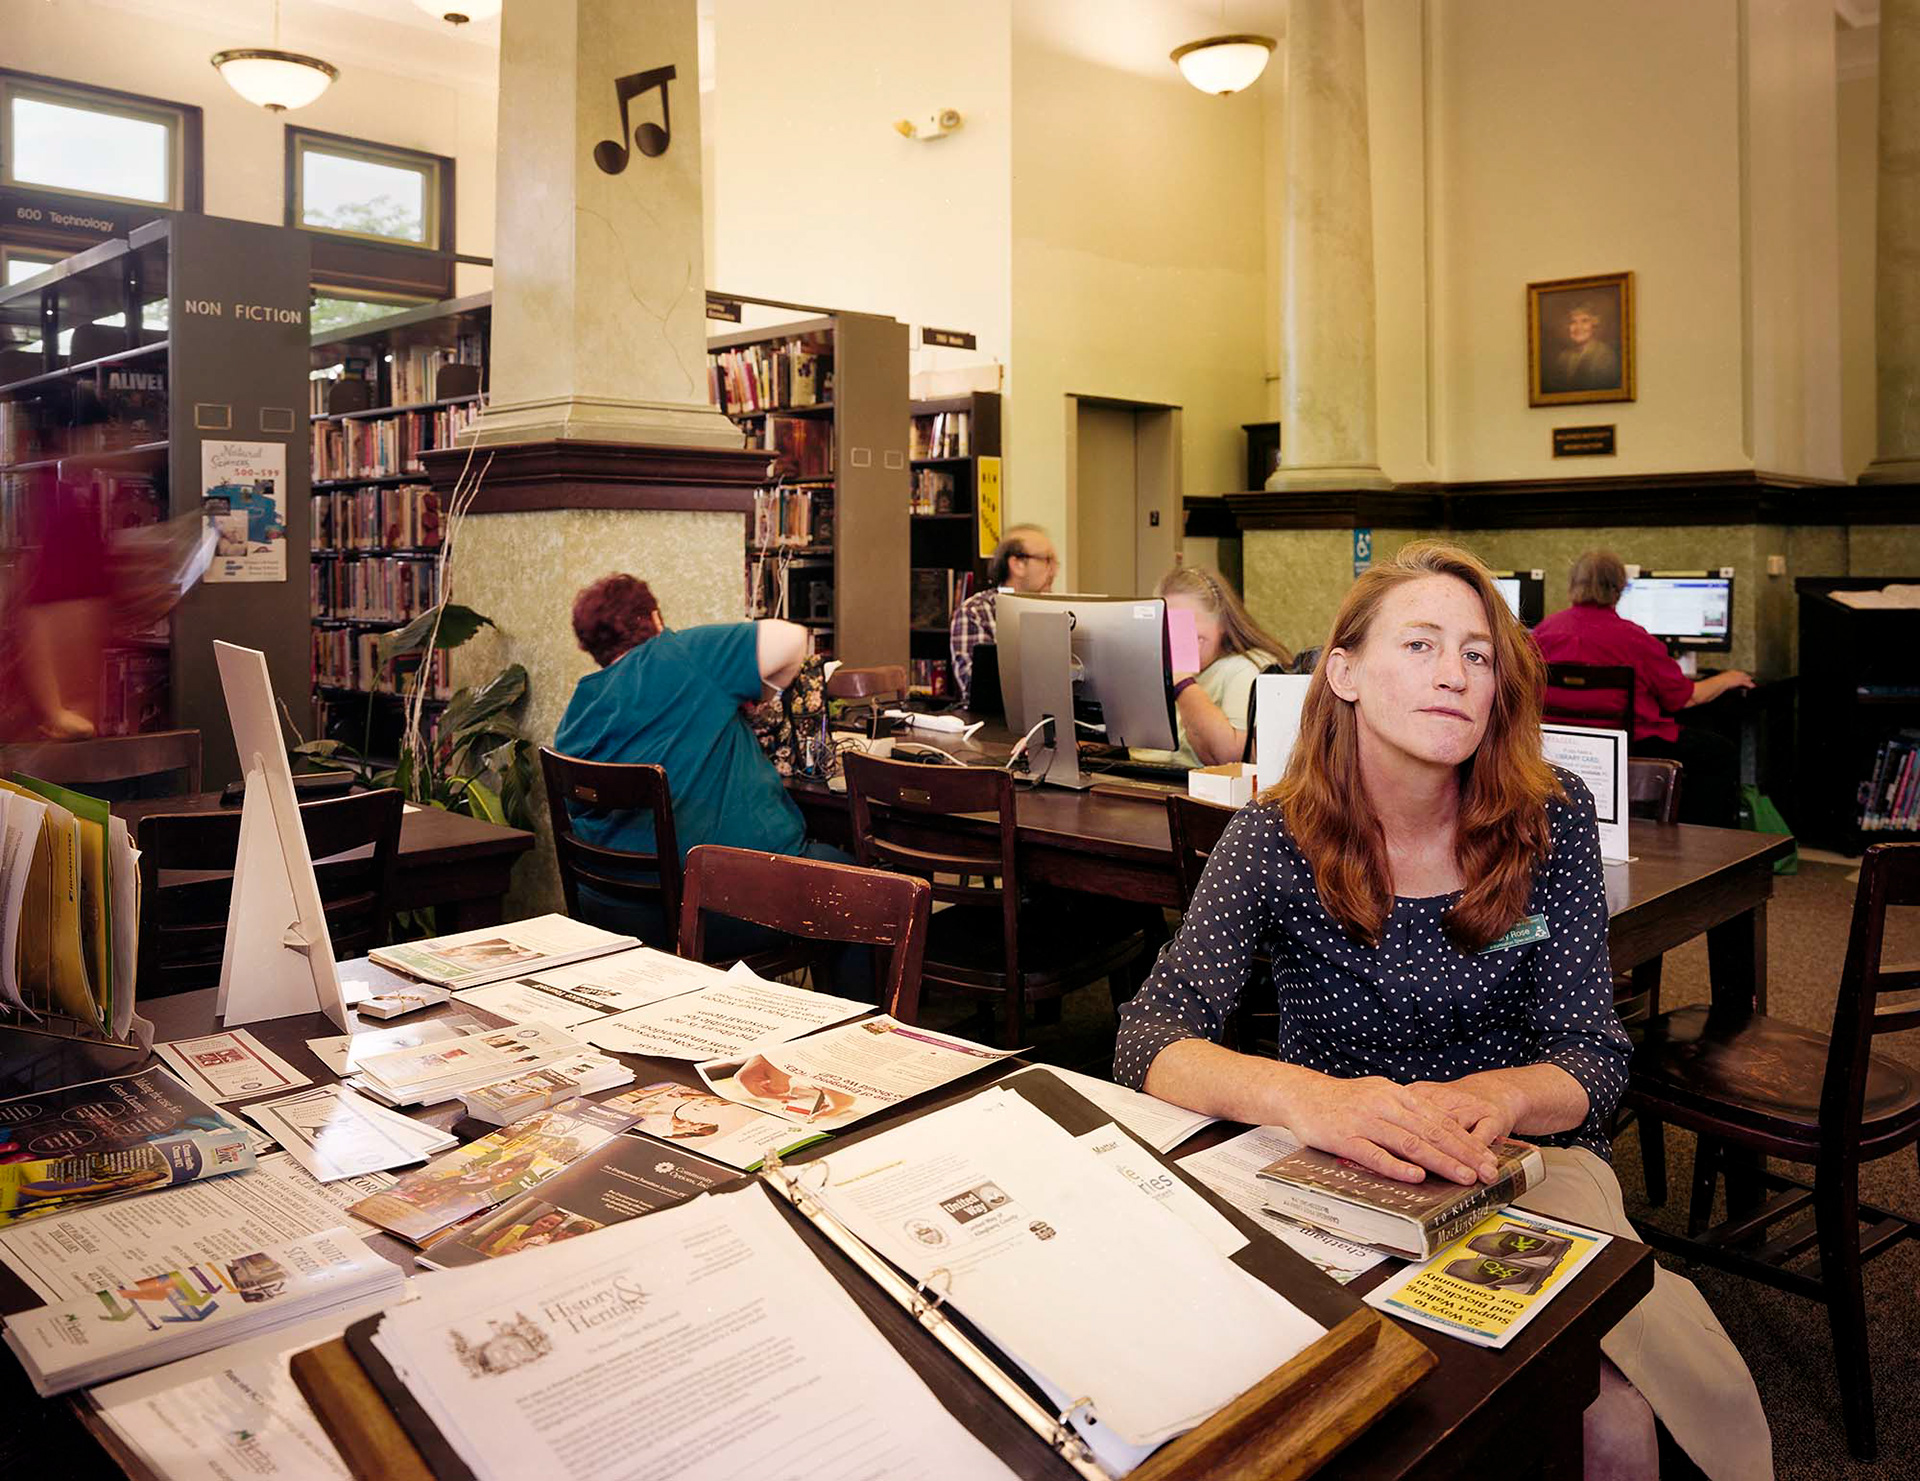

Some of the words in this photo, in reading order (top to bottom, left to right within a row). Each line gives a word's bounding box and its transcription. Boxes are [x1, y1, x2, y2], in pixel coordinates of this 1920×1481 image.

[17, 207, 42, 220] 600
[48, 211, 114, 232] Technology
[185, 300, 222, 316] NON
[235, 304, 302, 324] FICTION
[109, 371, 163, 390] ALIVE!
[220, 444, 263, 458] Natural
[1510, 928, 1531, 939] Rose
[701, 1017, 766, 1036] responsible
[727, 1015, 779, 1032] personal
[736, 1033, 758, 1042] The
[669, 1171, 697, 1186] Options,
[675, 1166, 715, 1184] Community
[1286, 1159, 1433, 1204] Mockingbird
[942, 1193, 980, 1214] United
[966, 1201, 989, 1218] Way
[1434, 1212, 1447, 1227] TO
[1452, 1196, 1476, 1217] KILL
[1481, 1189, 1487, 1198] A
[1438, 1201, 1490, 1245] Mockingbird
[1299, 1227, 1366, 1258] chatham
[1412, 1279, 1430, 1288] in
[1419, 1271, 1498, 1302] Community
[544, 1286, 615, 1323] History
[613, 1275, 652, 1304] &
[1400, 1283, 1459, 1308] Walking
[1411, 1298, 1429, 1307] to
[1426, 1283, 1490, 1309] Bicycling
[1495, 1296, 1526, 1310] Our
[568, 1300, 650, 1335] Heritage
[1427, 1303, 1467, 1321] Ways
[1456, 1302, 1512, 1326] Support
[1488, 1303, 1517, 1318] and
[1464, 1316, 1486, 1328] 25
